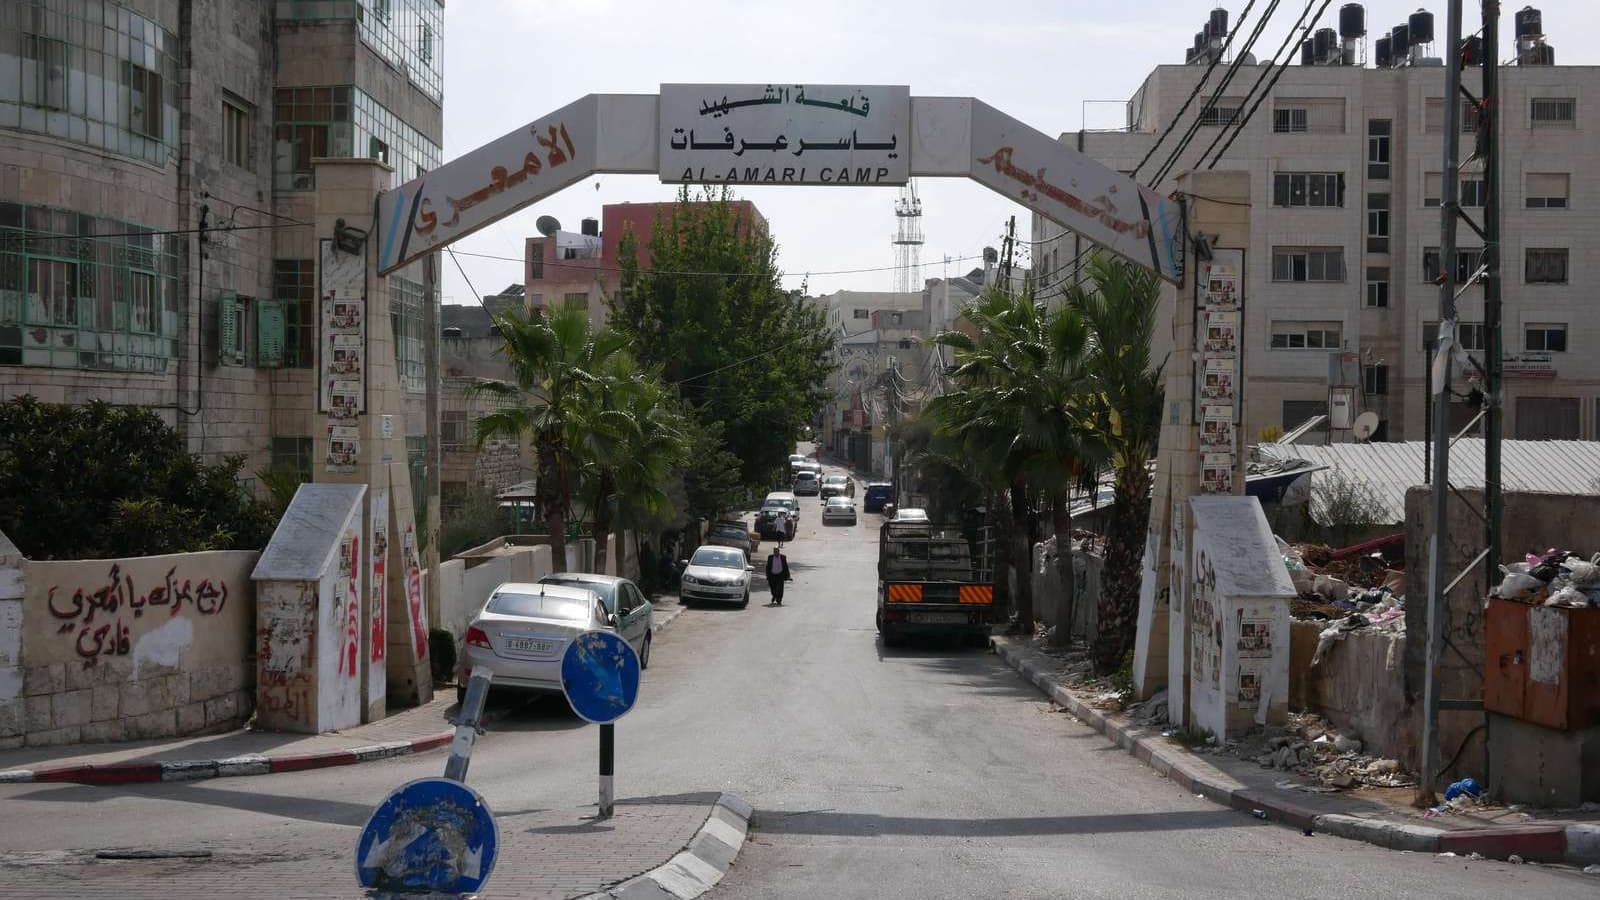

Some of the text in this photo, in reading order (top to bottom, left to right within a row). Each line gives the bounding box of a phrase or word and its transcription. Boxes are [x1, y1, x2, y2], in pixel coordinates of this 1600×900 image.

[699, 84, 870, 118] قلعة الشهيد
[670, 126, 898, 159] ياسر عرفات
[681, 167, 889, 183] AL-AMARI CAMP
